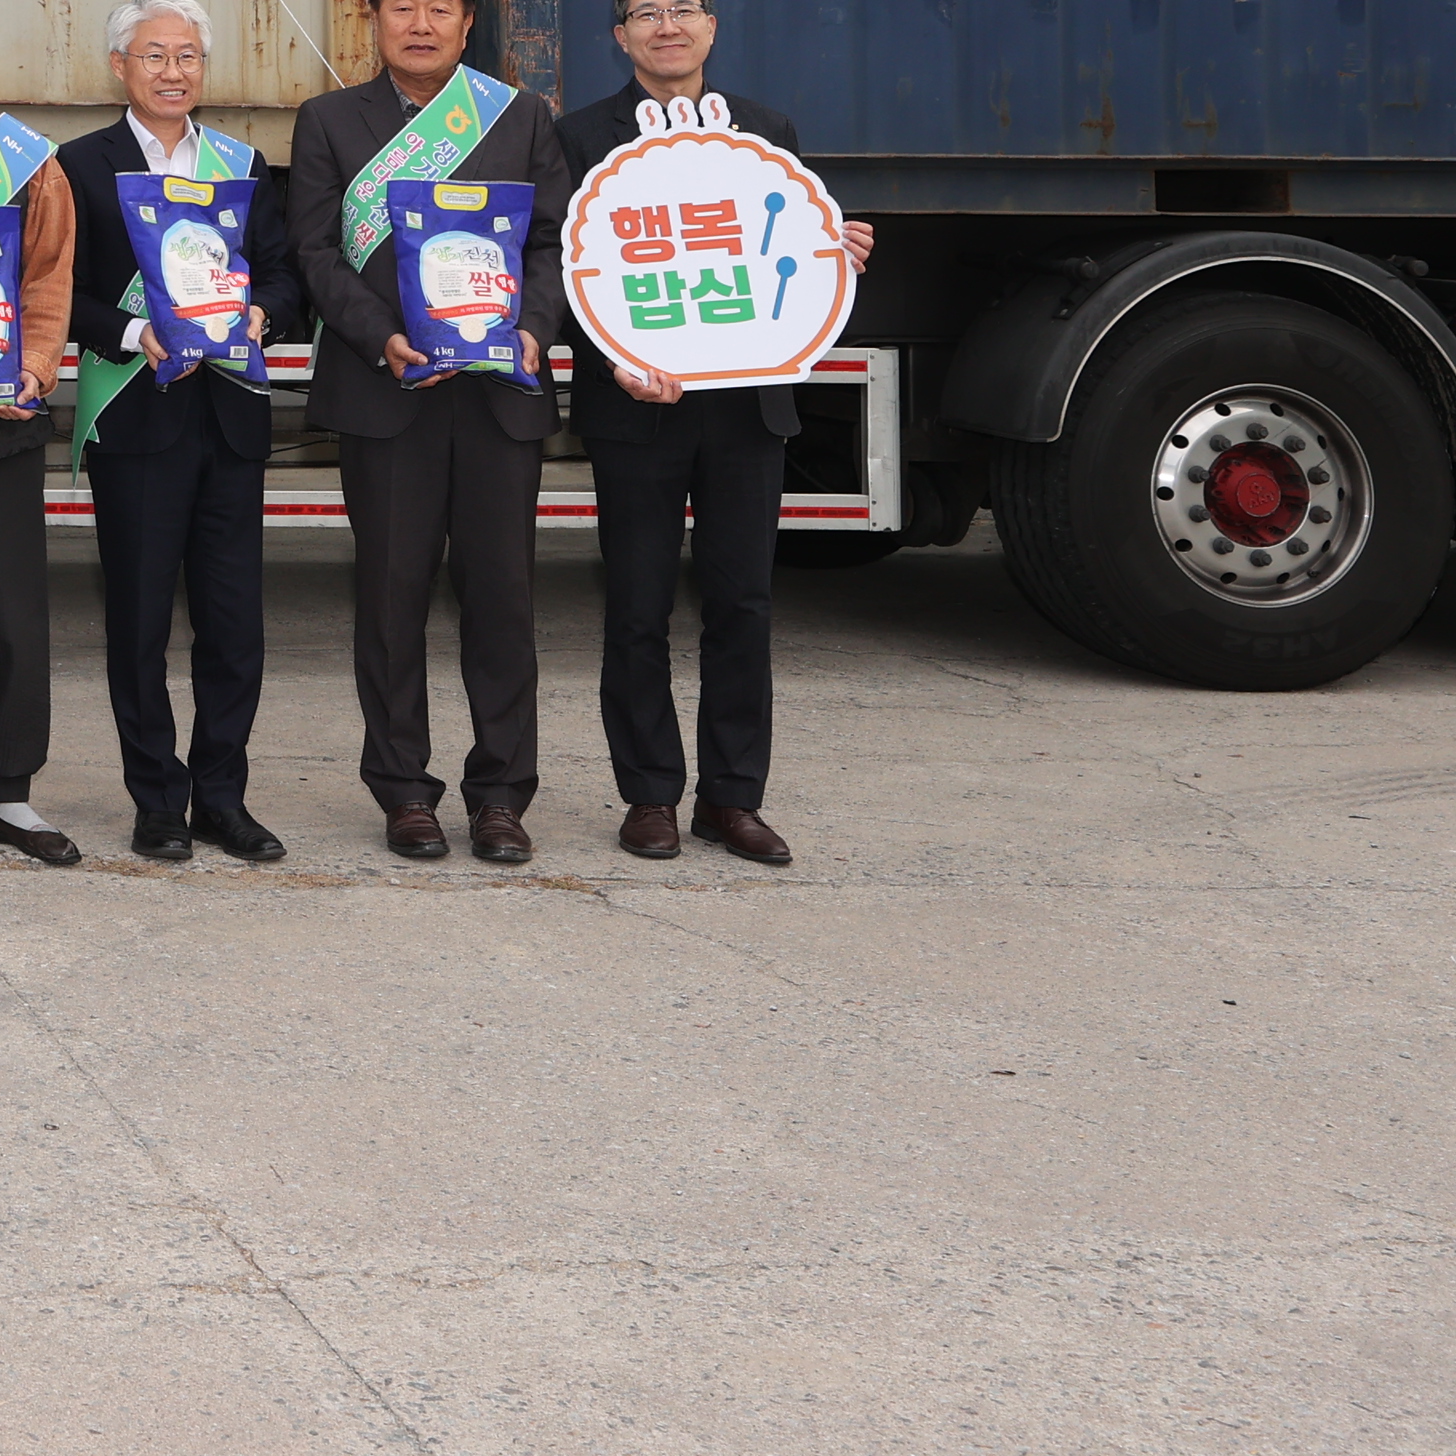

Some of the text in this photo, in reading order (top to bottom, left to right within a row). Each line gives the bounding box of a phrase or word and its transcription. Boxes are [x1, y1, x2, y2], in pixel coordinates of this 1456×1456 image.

[471, 77, 491, 97] NH
[2, 135, 25, 155] NH
[354, 131, 426, 202] 아름다운
[608, 198, 744, 265] 행복
[209, 268, 233, 295] 쌀
[467, 271, 494, 298] 쌀
[620, 264, 757, 331] 밥심
